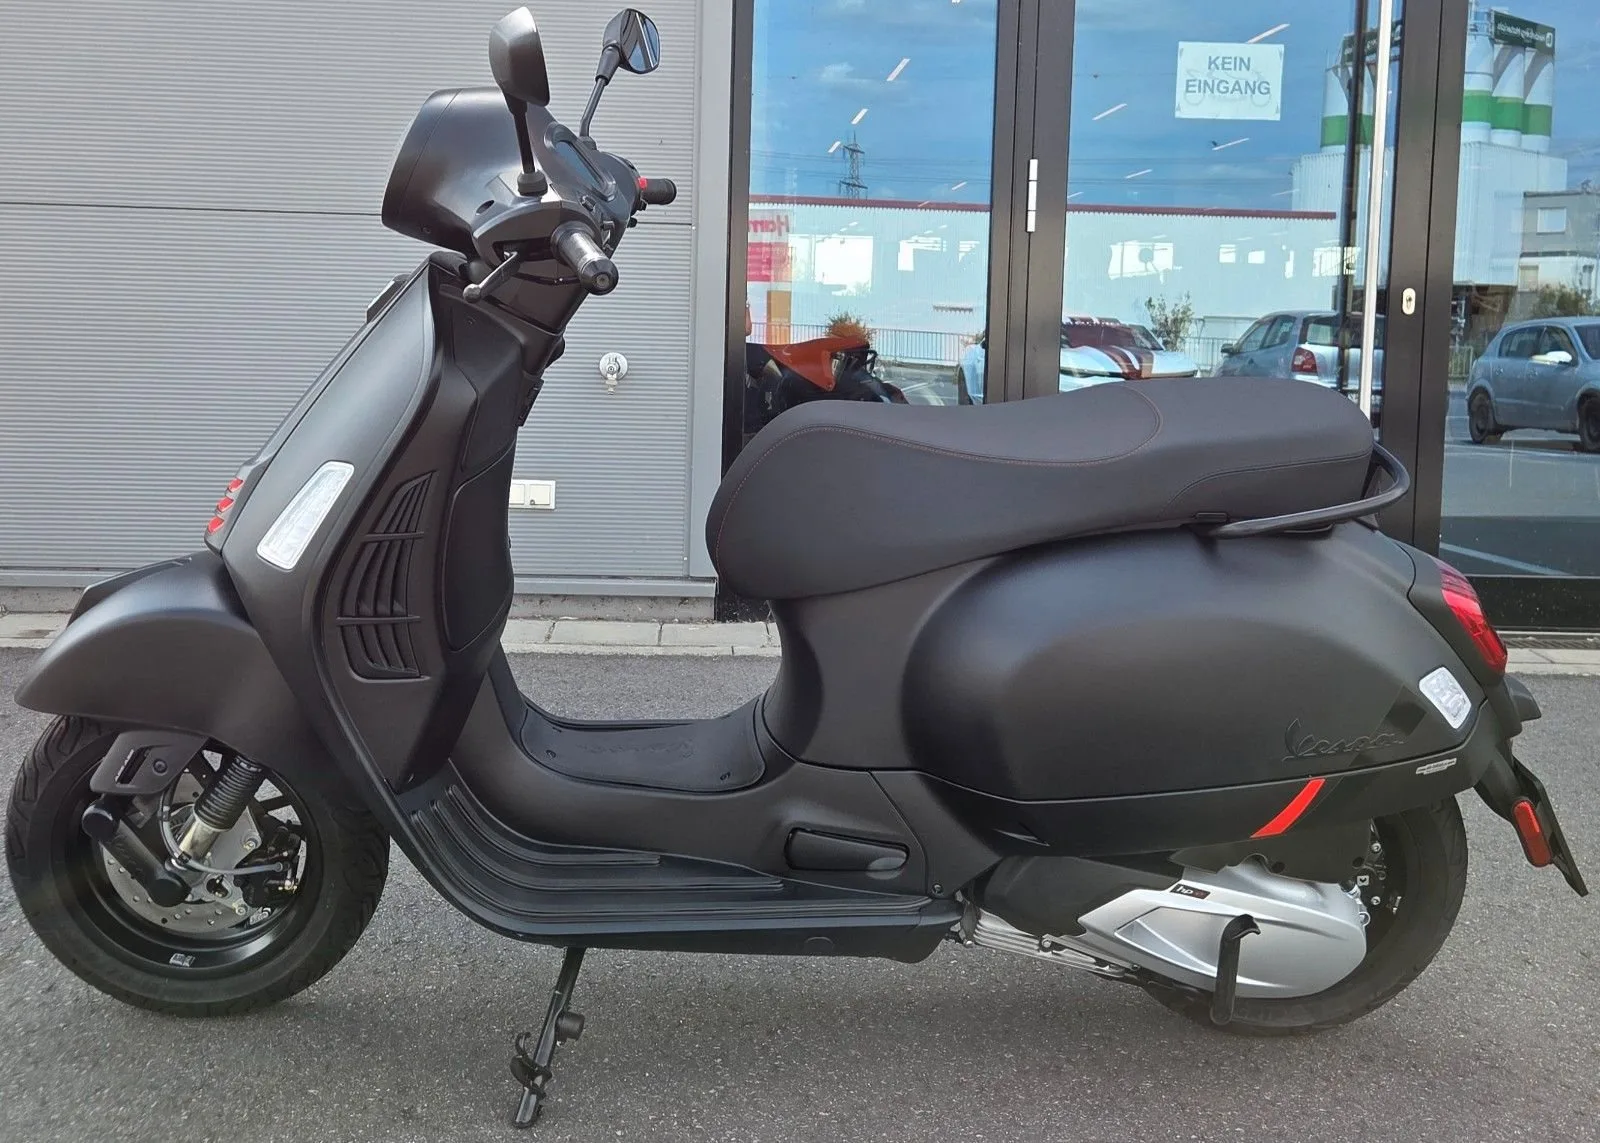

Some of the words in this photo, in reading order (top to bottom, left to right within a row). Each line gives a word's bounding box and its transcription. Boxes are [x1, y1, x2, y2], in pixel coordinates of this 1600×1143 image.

[1207, 55, 1251, 71] KEIN
[1185, 79, 1271, 95] EINGANG
[1282, 718, 1404, 762] Vespa
